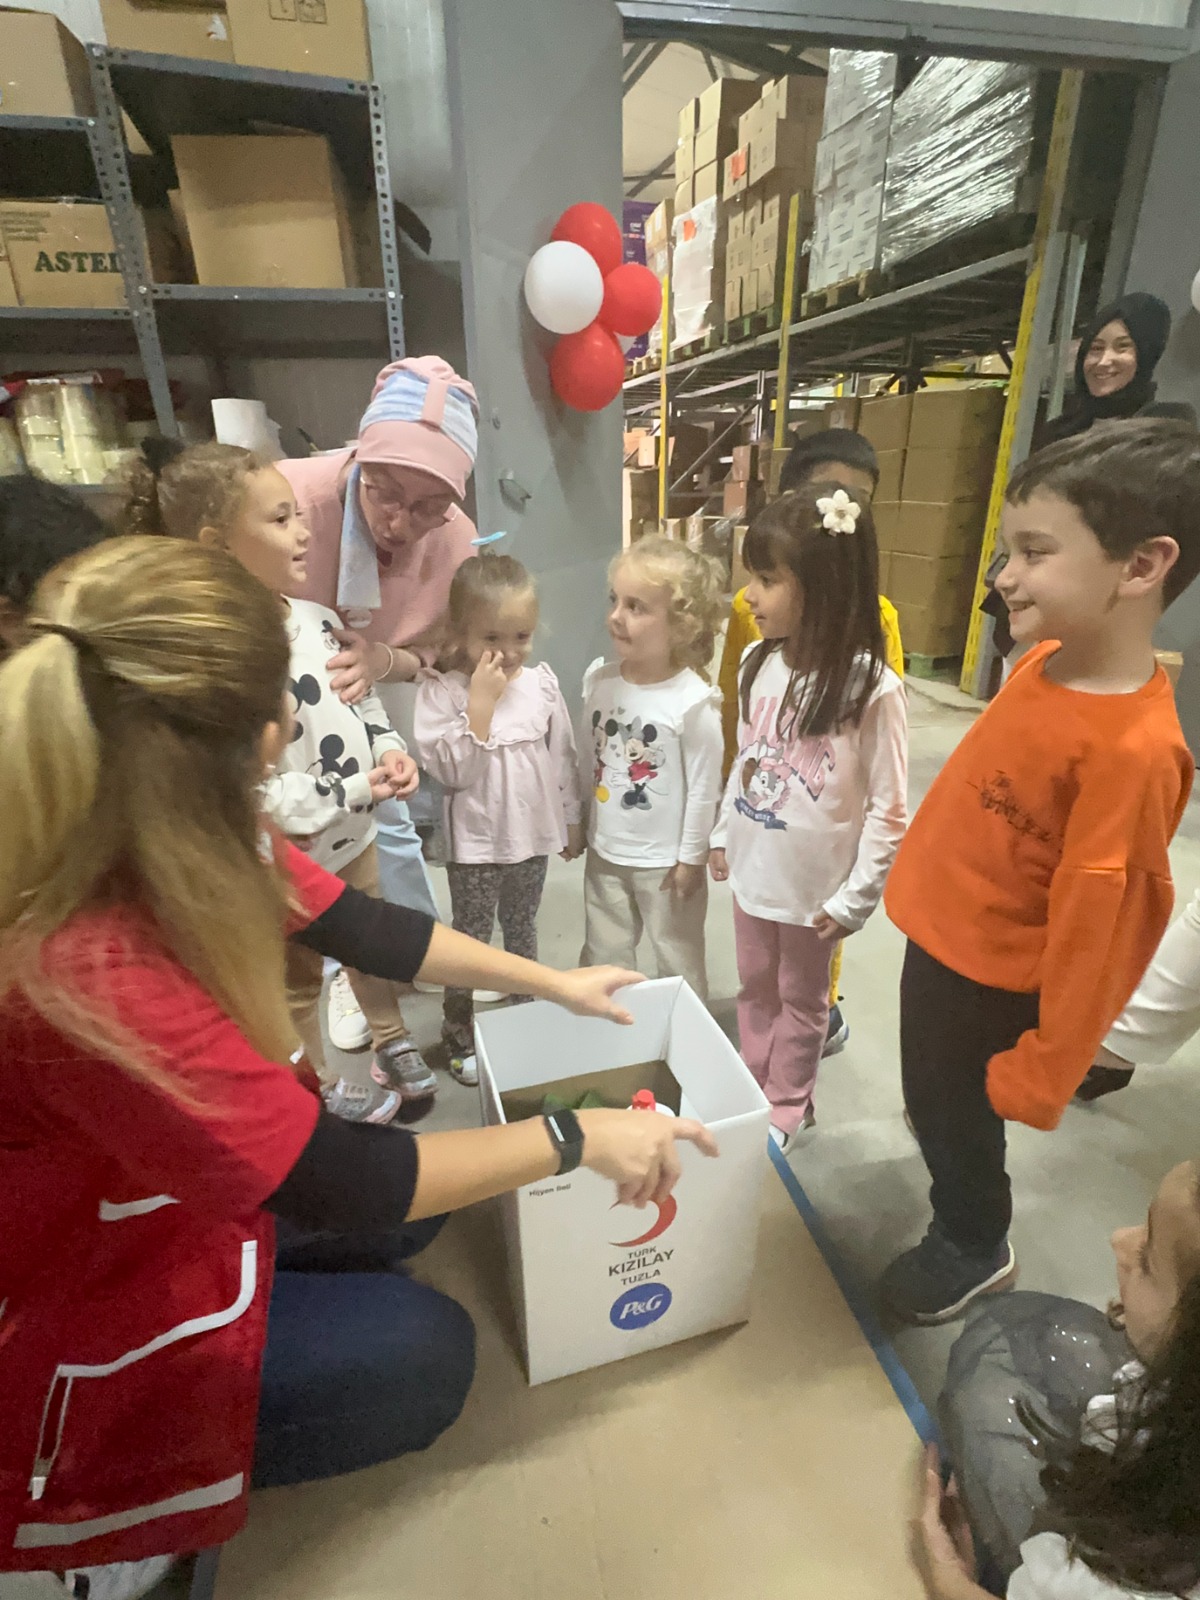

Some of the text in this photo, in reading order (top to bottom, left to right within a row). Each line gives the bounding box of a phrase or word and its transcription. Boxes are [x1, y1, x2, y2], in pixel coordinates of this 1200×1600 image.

[608, 1249, 674, 1277] KIZILAY
[621, 1269, 661, 1286] TUZLA
[619, 1293, 664, 1320] P&G
